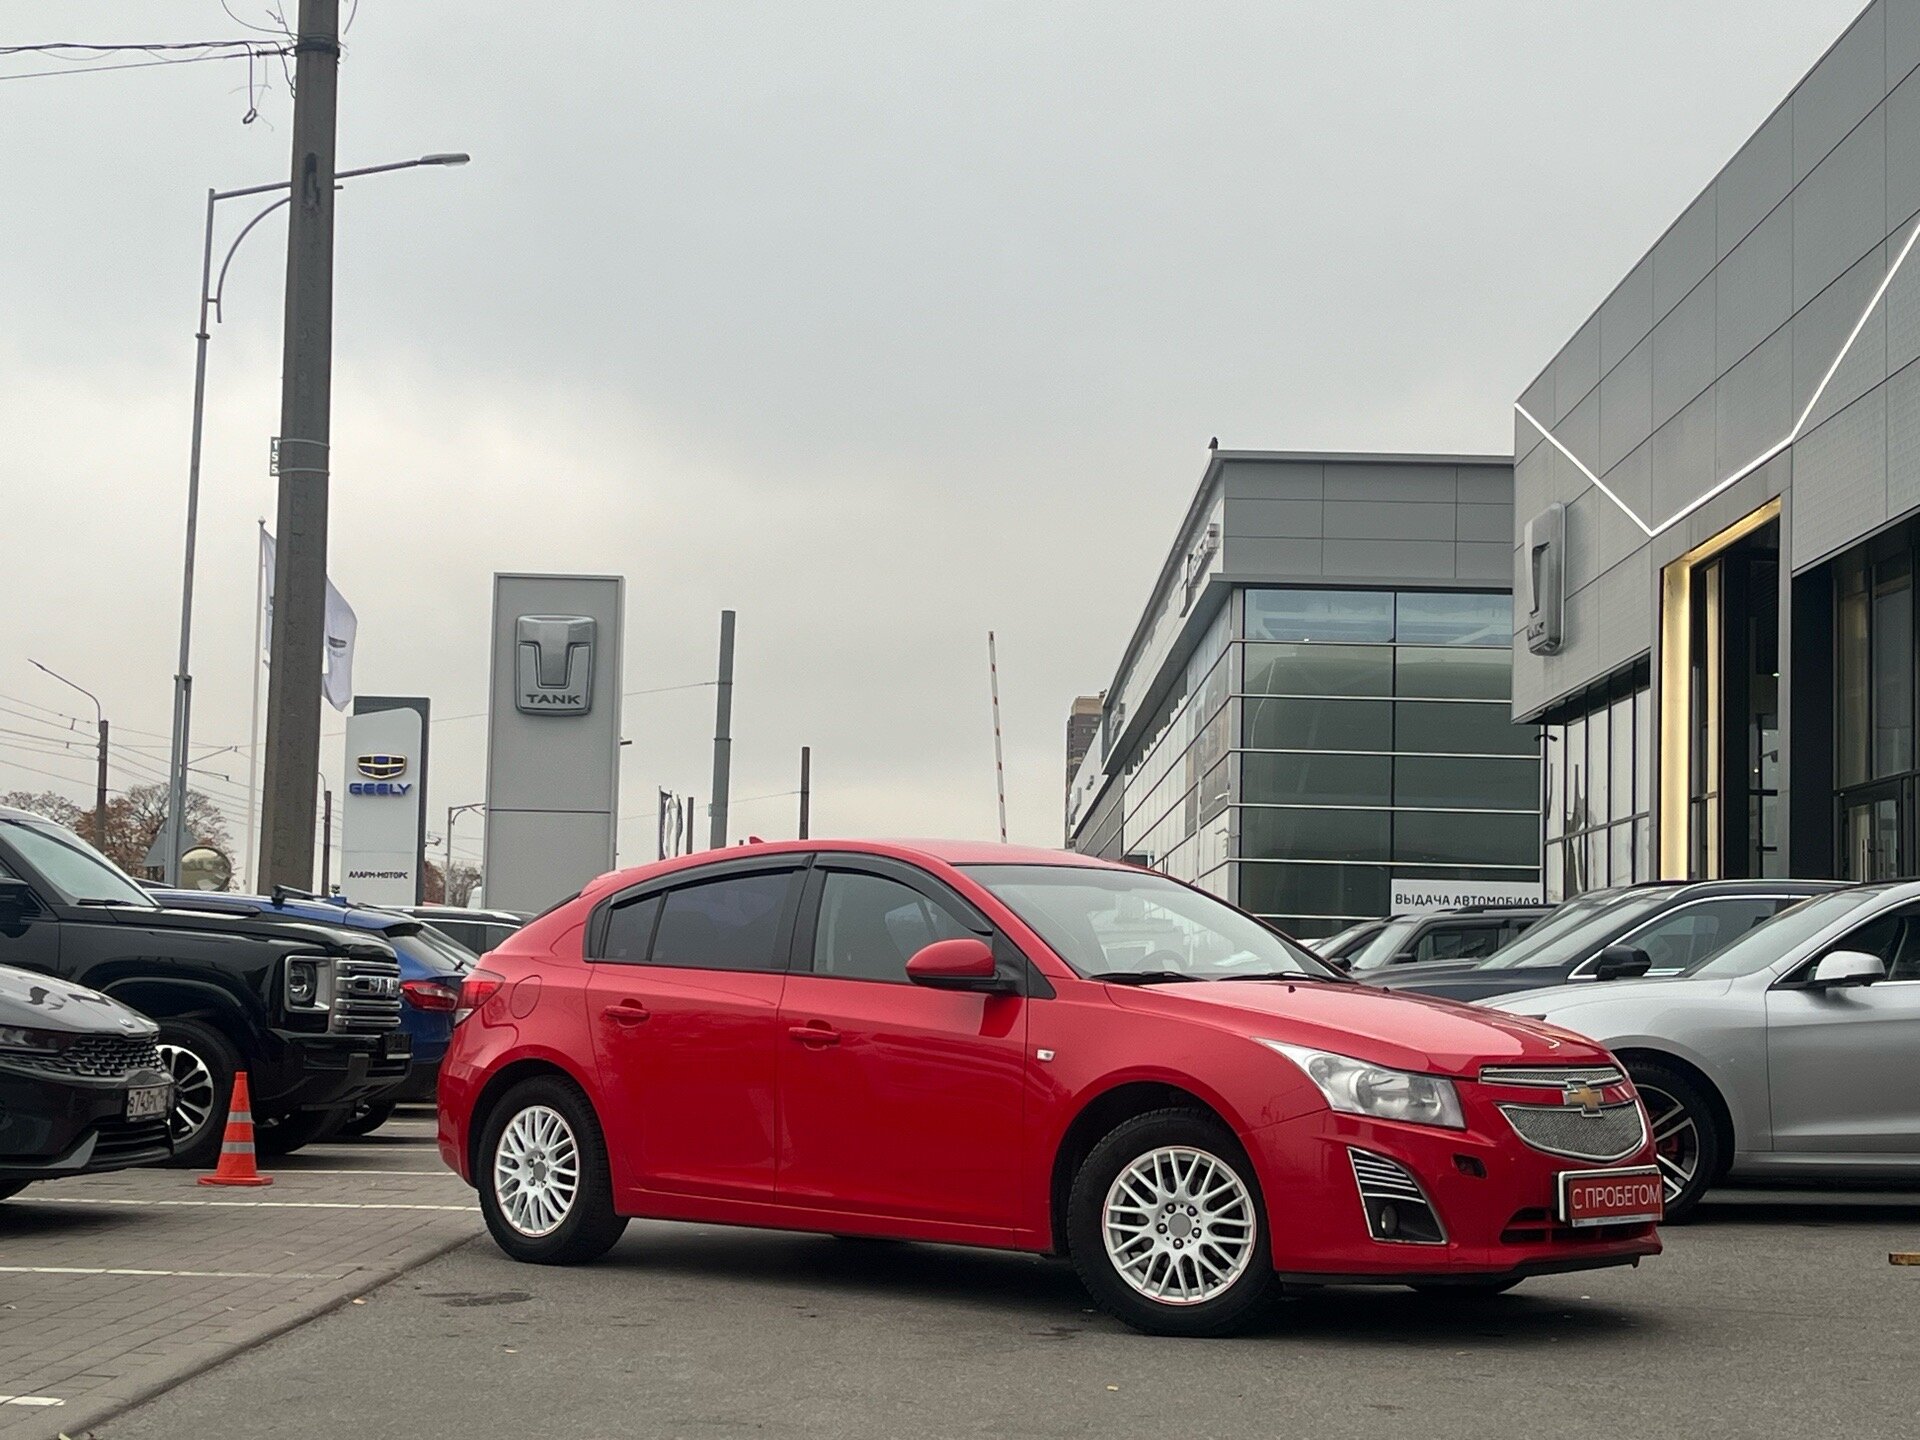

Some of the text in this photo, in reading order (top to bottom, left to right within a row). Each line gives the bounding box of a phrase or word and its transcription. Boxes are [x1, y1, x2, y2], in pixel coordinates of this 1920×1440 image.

[525, 694, 580, 705] TANK
[349, 783, 412, 795] GEELY
[1395, 893, 1450, 906] ВЫДАЧА
[1572, 1184, 1661, 1209] С ПРОБЕГОМ
